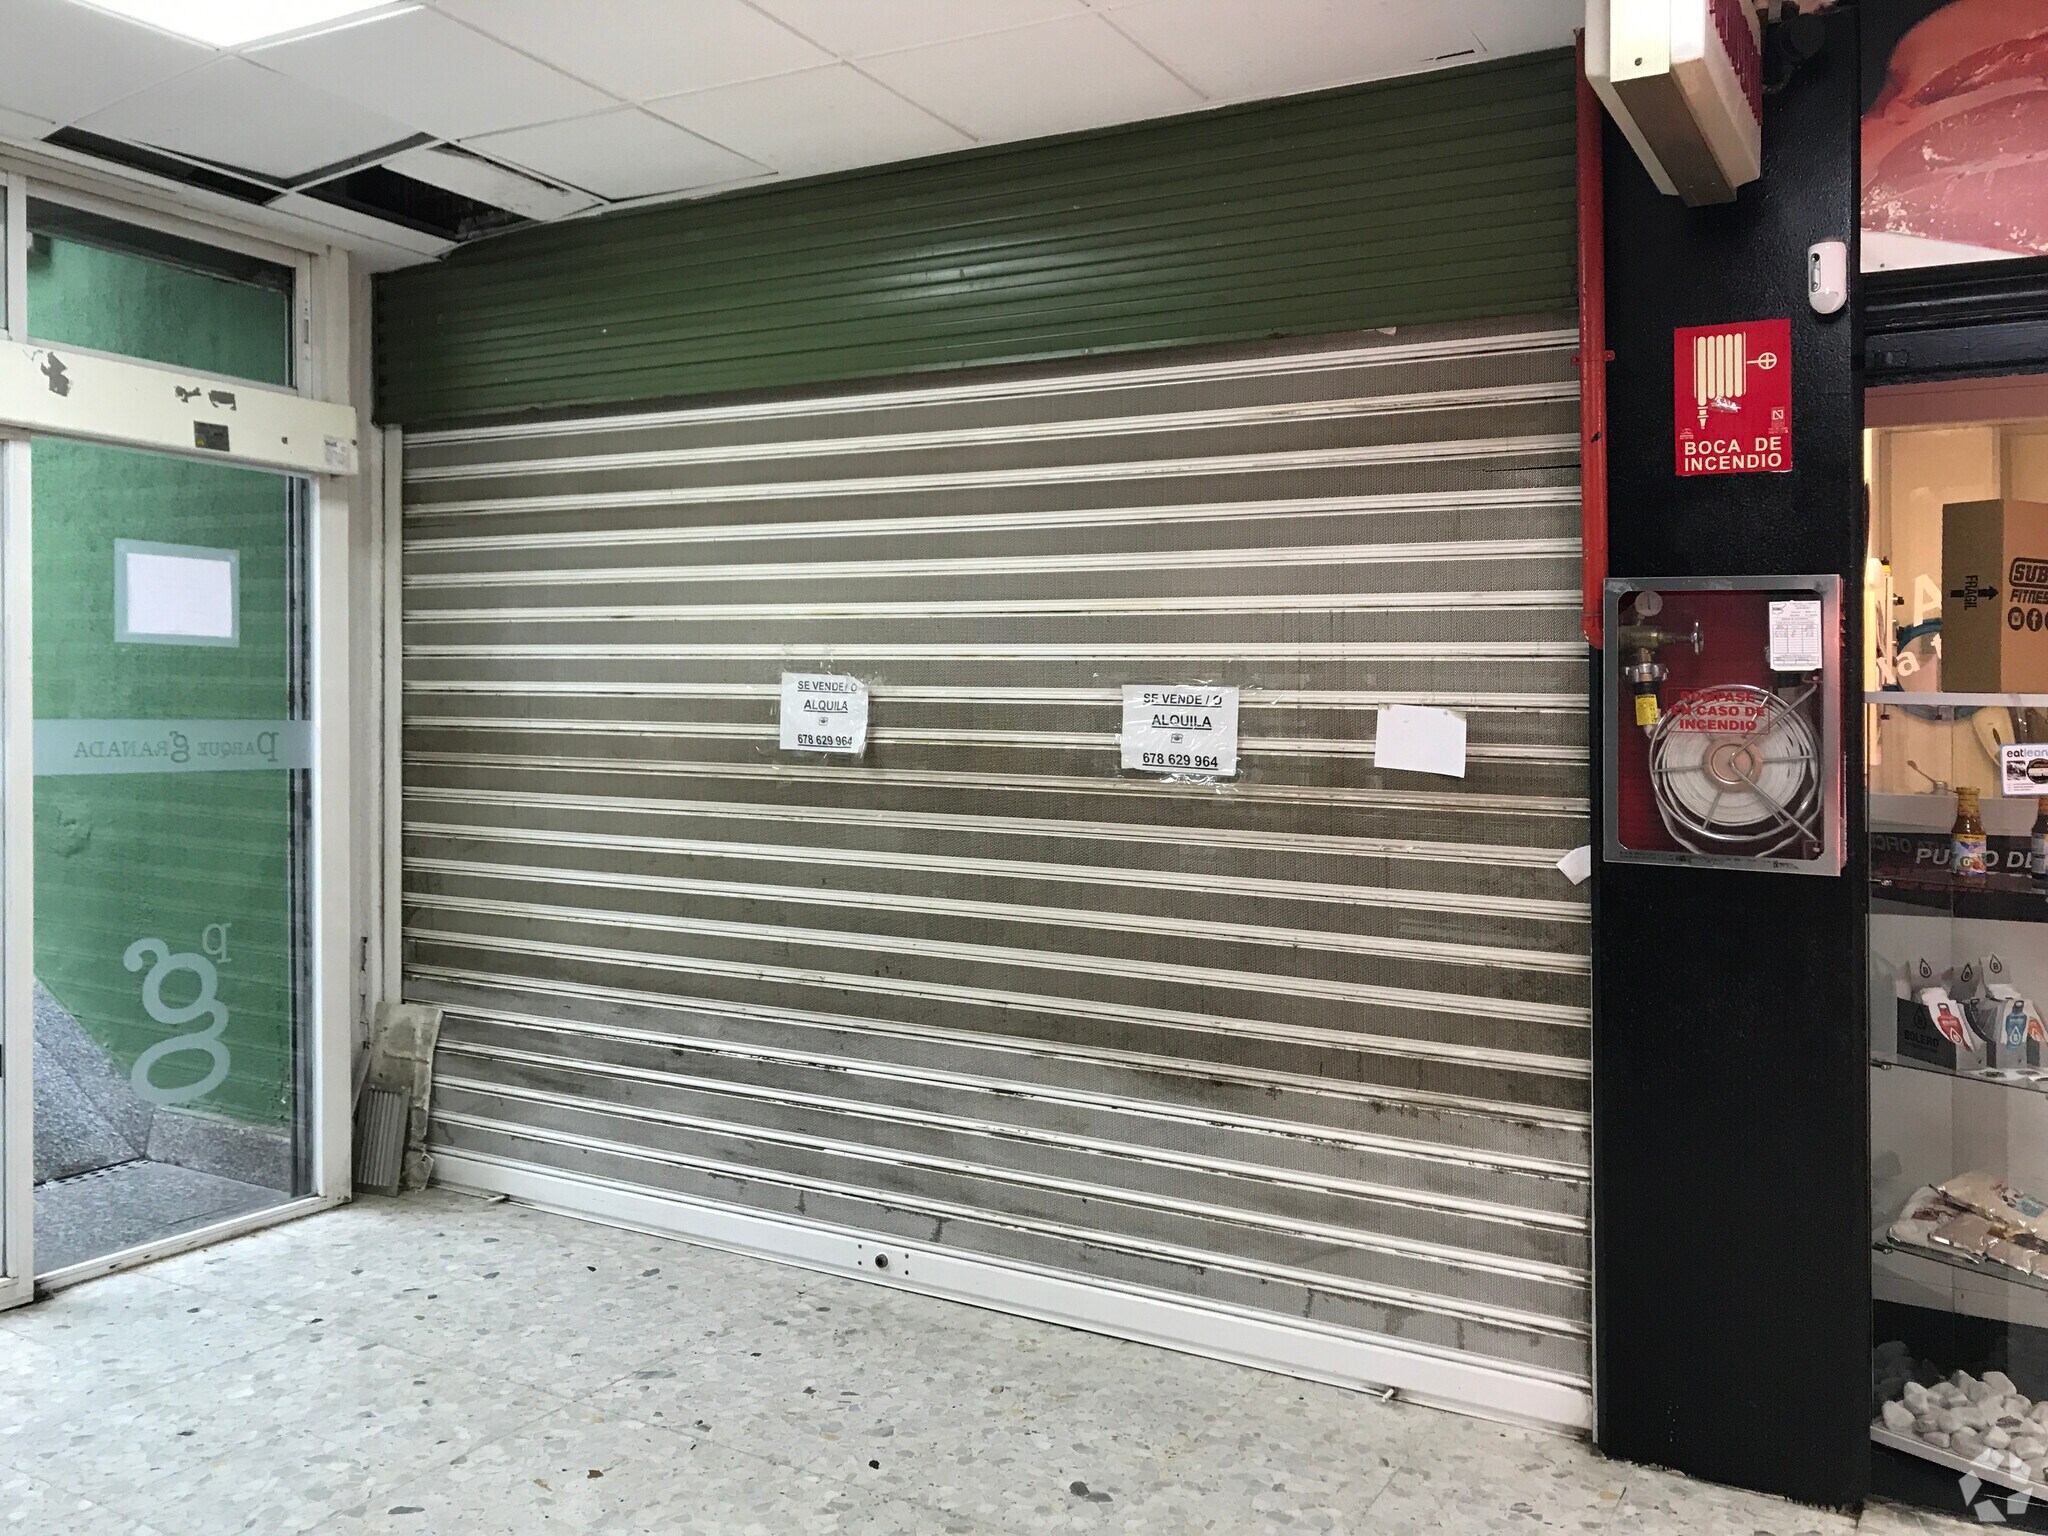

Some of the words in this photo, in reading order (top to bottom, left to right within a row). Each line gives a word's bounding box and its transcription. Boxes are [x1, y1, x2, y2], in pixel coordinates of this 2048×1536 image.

[1684, 439, 1741, 456] BOCA
[1755, 436, 1782, 452] DE
[1684, 453, 1782, 472] INCENDIO
[1964, 575, 1979, 611] FRAGIL
[797, 680, 810, 690] SE
[803, 699, 849, 711] ALQUILA
[1143, 693, 1159, 704] SE
[1162, 693, 1203, 705] VENDE
[1671, 705, 1692, 716] EN
[1696, 705, 1740, 717] CASO
[1744, 706, 1765, 717] DE
[1151, 714, 1212, 728] ALQUILA
[1679, 719, 1757, 730] INCENDIO
[797, 733, 814, 745] 678
[815, 734, 834, 746] 629
[835, 735, 853, 747] 964
[1142, 752, 1165, 765] 678
[1168, 753, 1191, 766] 629
[1194, 755, 1219, 768] 964
[1915, 847, 2000, 869] PUO
